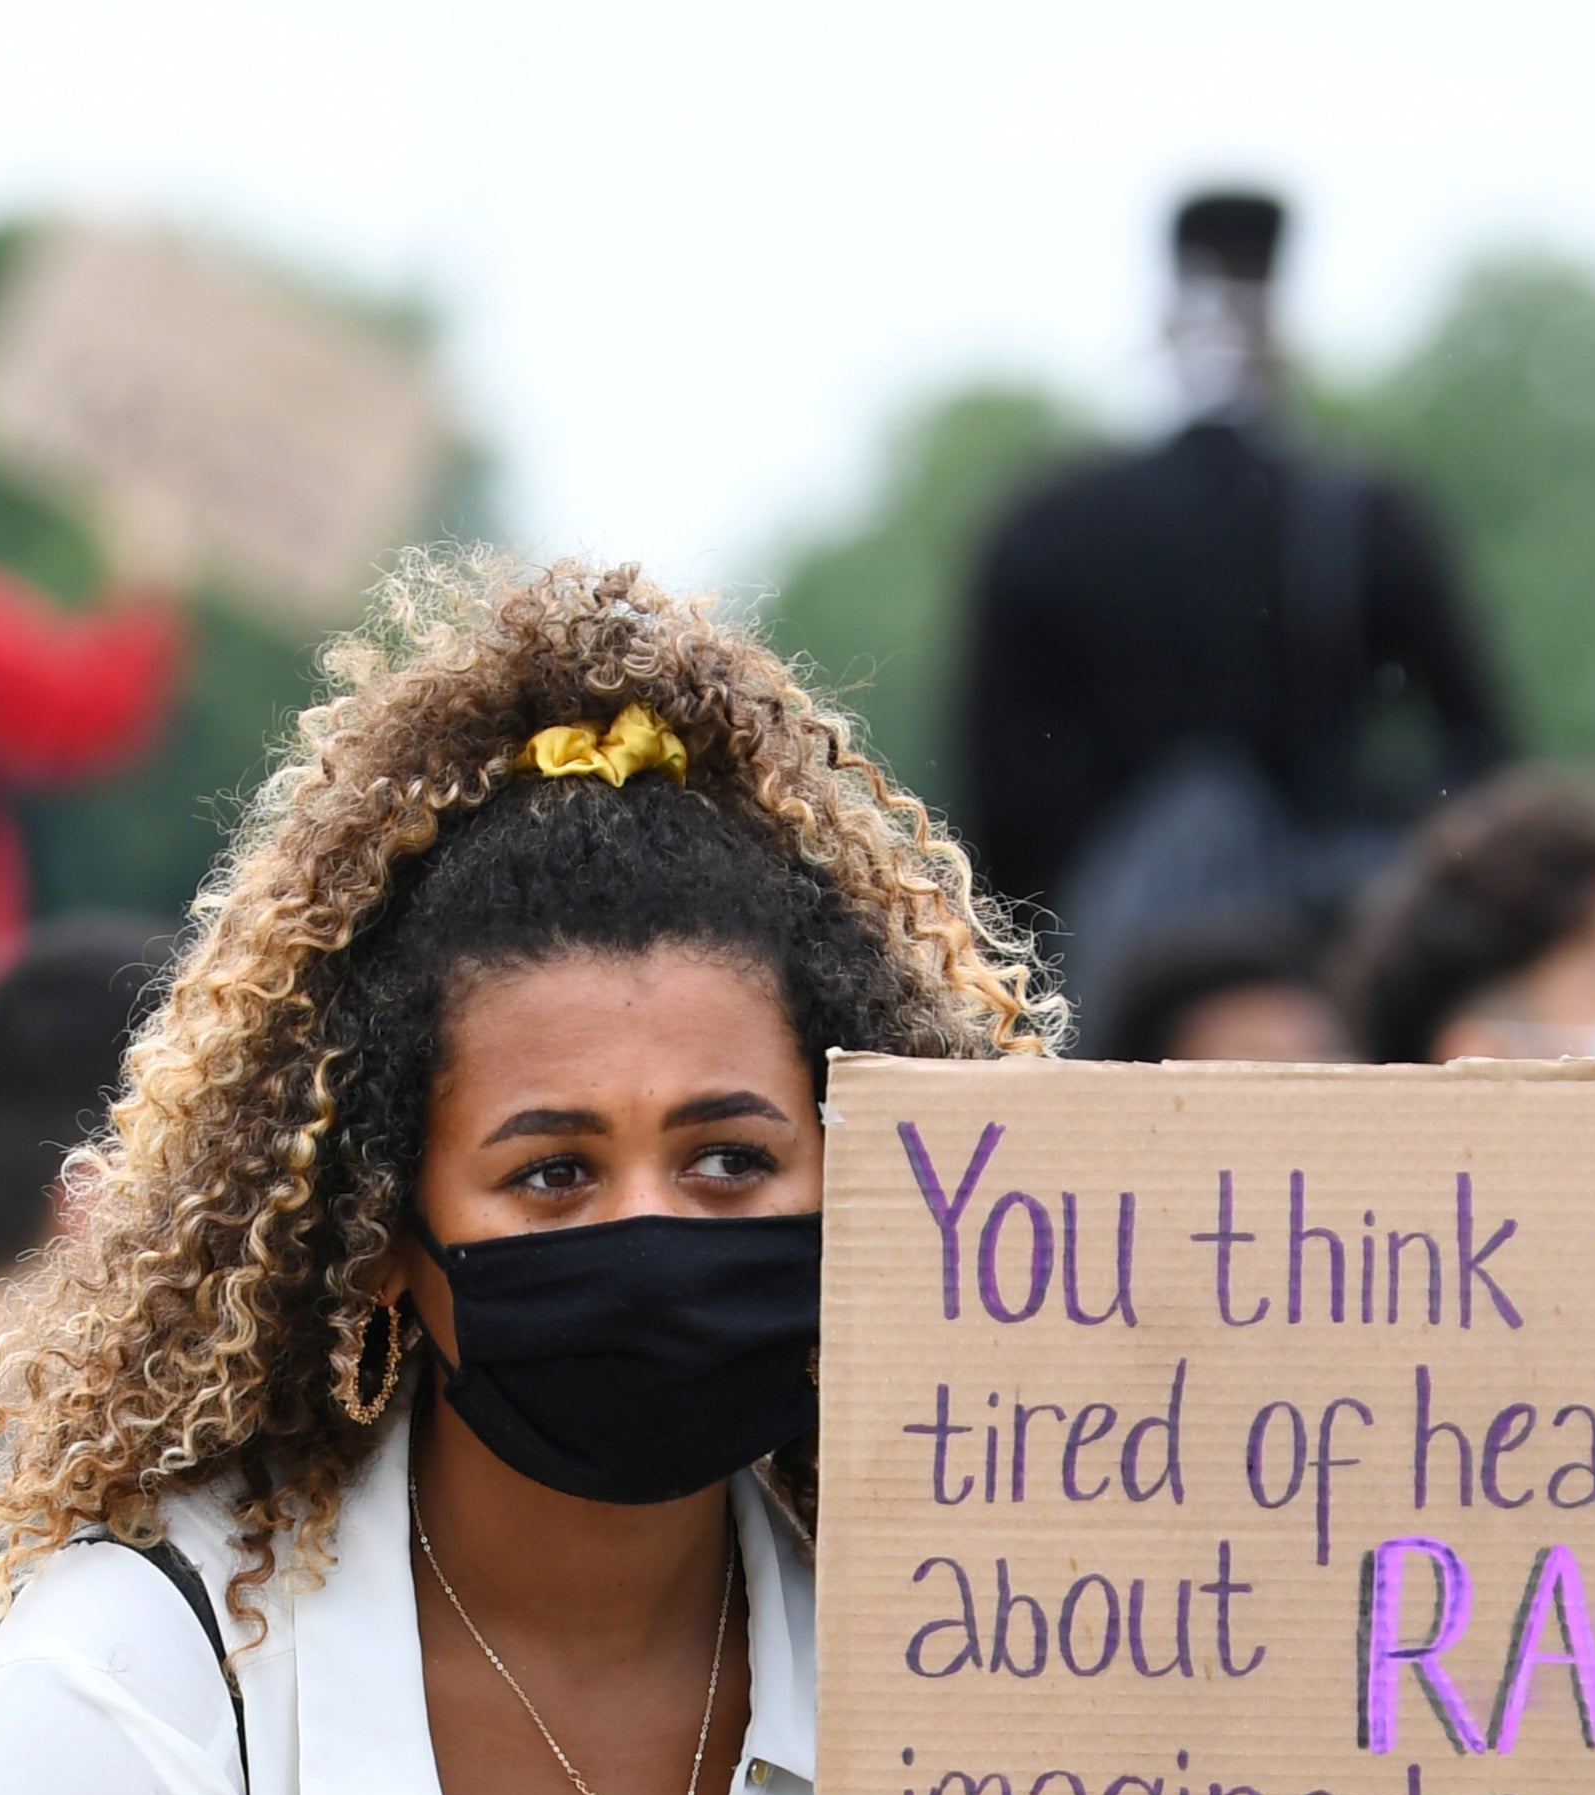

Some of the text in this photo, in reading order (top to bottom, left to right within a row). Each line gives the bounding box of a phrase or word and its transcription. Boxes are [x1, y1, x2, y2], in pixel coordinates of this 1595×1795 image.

[897, 1122, 1136, 1326] You
[1192, 1170, 1523, 1330] think
[905, 1360, 1187, 1505] tired
[1246, 1399, 1374, 1565] of
[906, 1540, 1265, 1677] about
